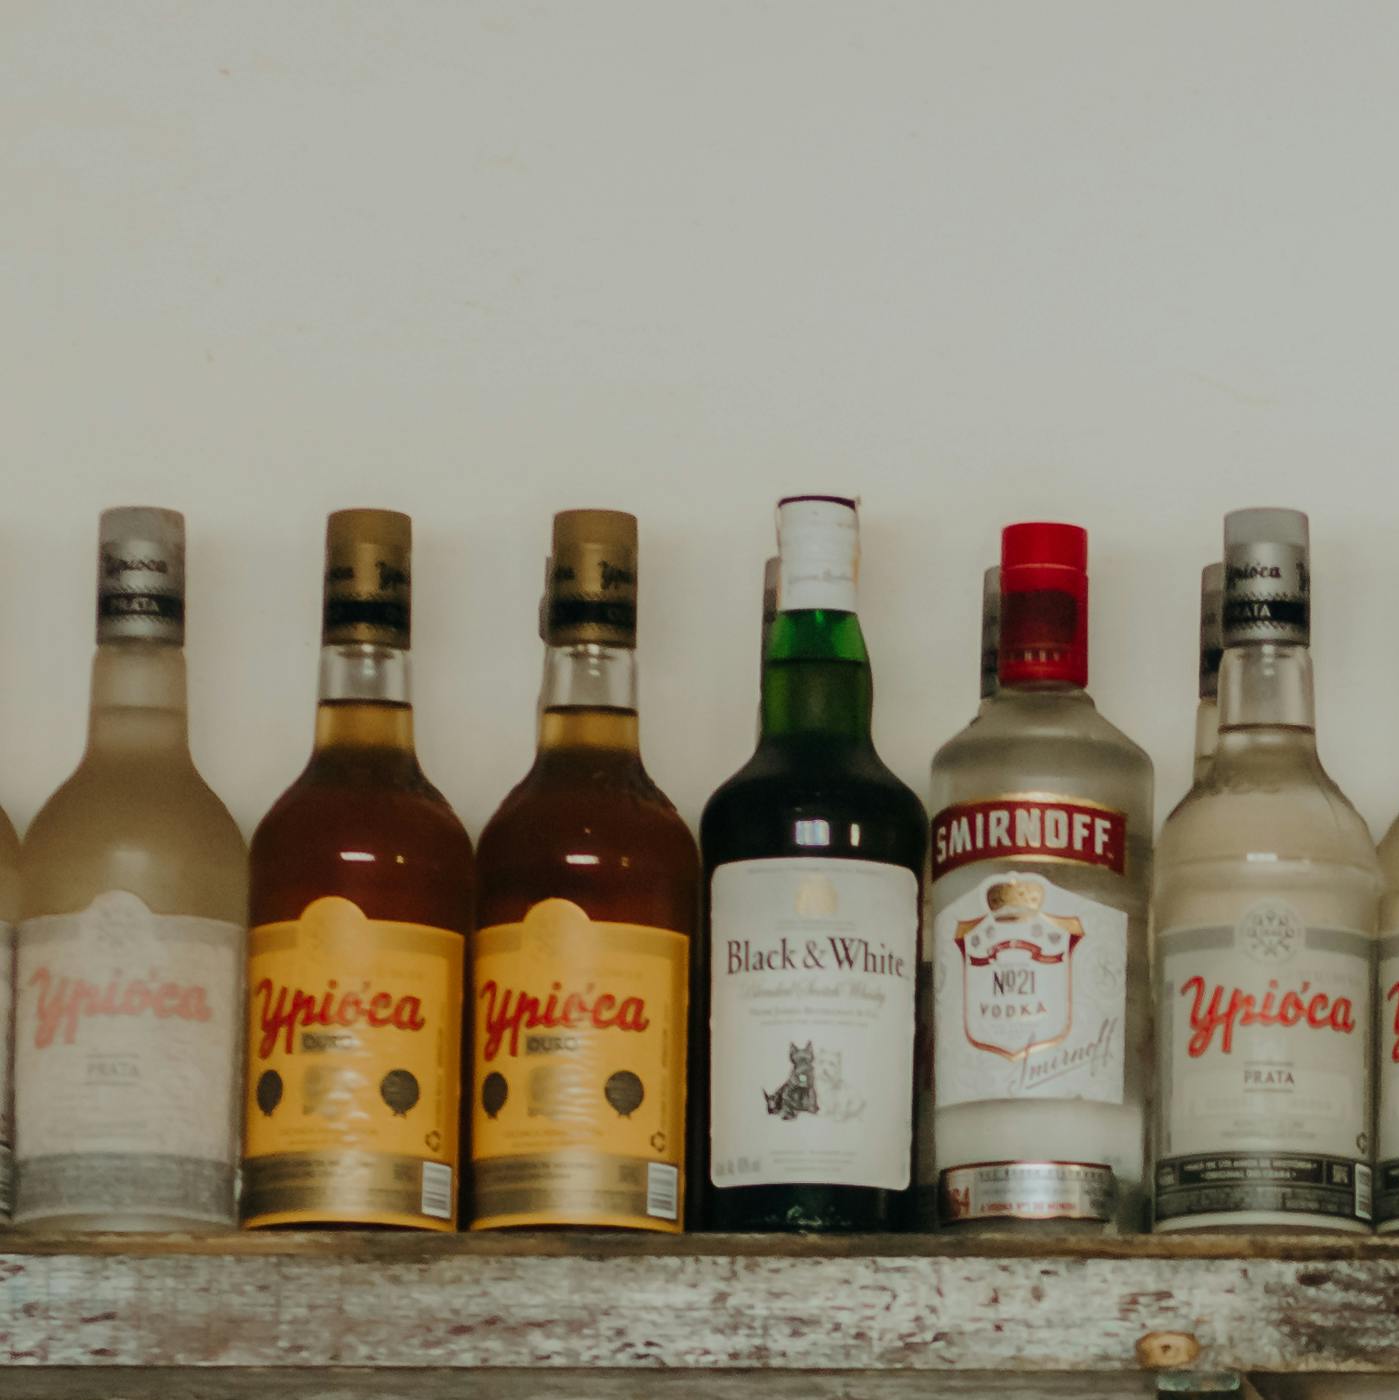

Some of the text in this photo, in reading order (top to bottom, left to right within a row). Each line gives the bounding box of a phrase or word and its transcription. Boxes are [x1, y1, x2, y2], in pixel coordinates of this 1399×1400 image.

[937, 808, 1113, 864] SMIRNOFF
[727, 936, 905, 979] Black & White
[256, 978, 425, 1061] Ypióca
[481, 980, 651, 1061] Ypióca
[980, 1000, 1048, 1019] VODKA
[1180, 975, 1356, 1059] Ypióca
[1243, 1069, 1295, 1086] PRATA
